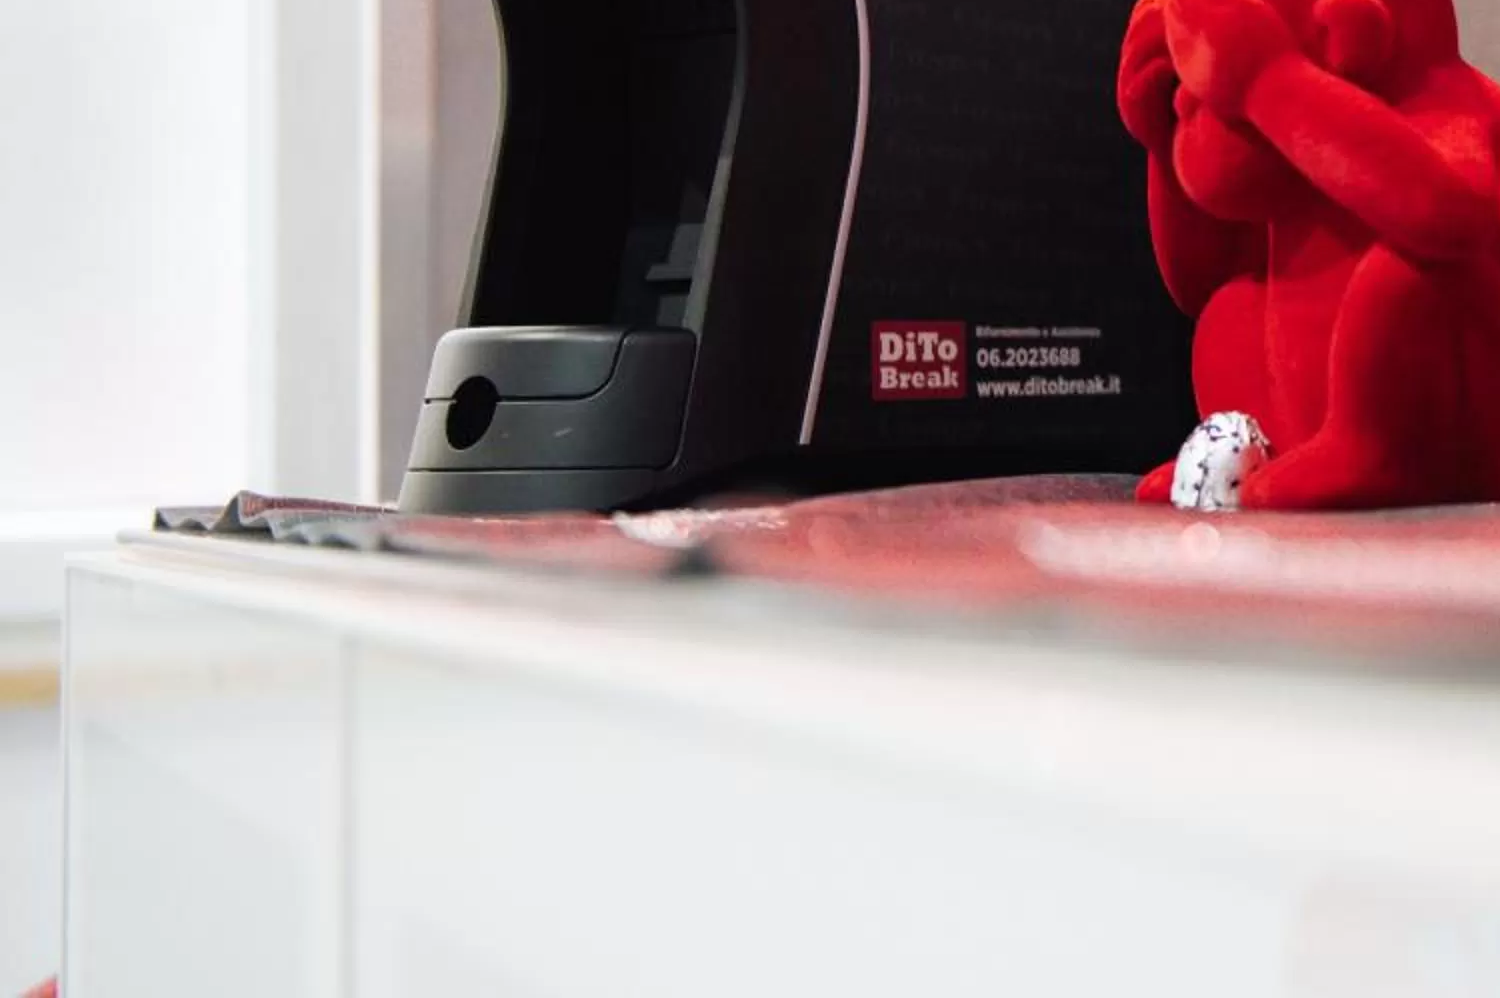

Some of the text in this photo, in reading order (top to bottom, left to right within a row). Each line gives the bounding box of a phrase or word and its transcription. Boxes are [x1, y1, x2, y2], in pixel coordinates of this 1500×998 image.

[879, 331, 958, 363] DiTo
[879, 366, 959, 389] Break
[976, 375, 1122, 397] www.ditobreak.it
